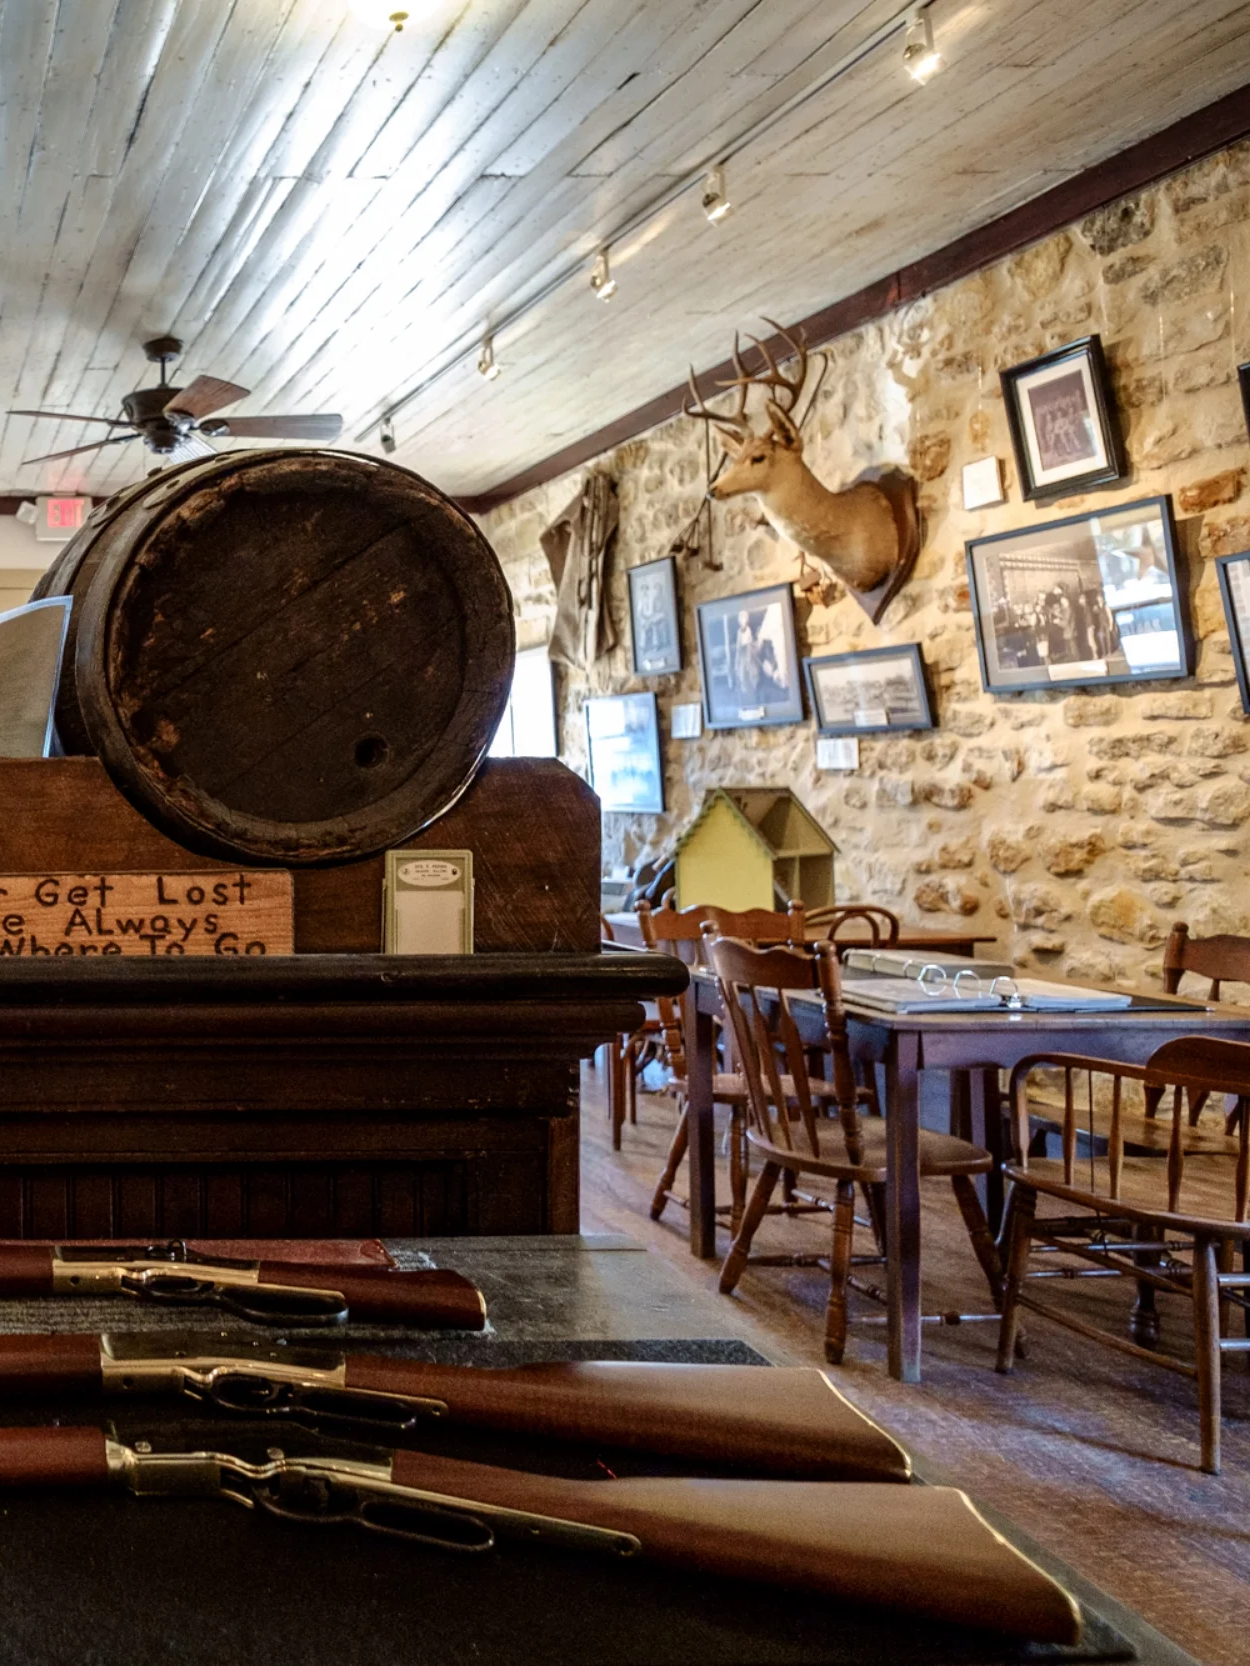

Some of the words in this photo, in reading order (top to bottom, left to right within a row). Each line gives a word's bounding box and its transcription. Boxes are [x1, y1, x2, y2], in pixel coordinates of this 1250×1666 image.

[47, 498, 85, 528] EXIT
[34, 876, 115, 908] Get
[156, 873, 252, 906] Lost
